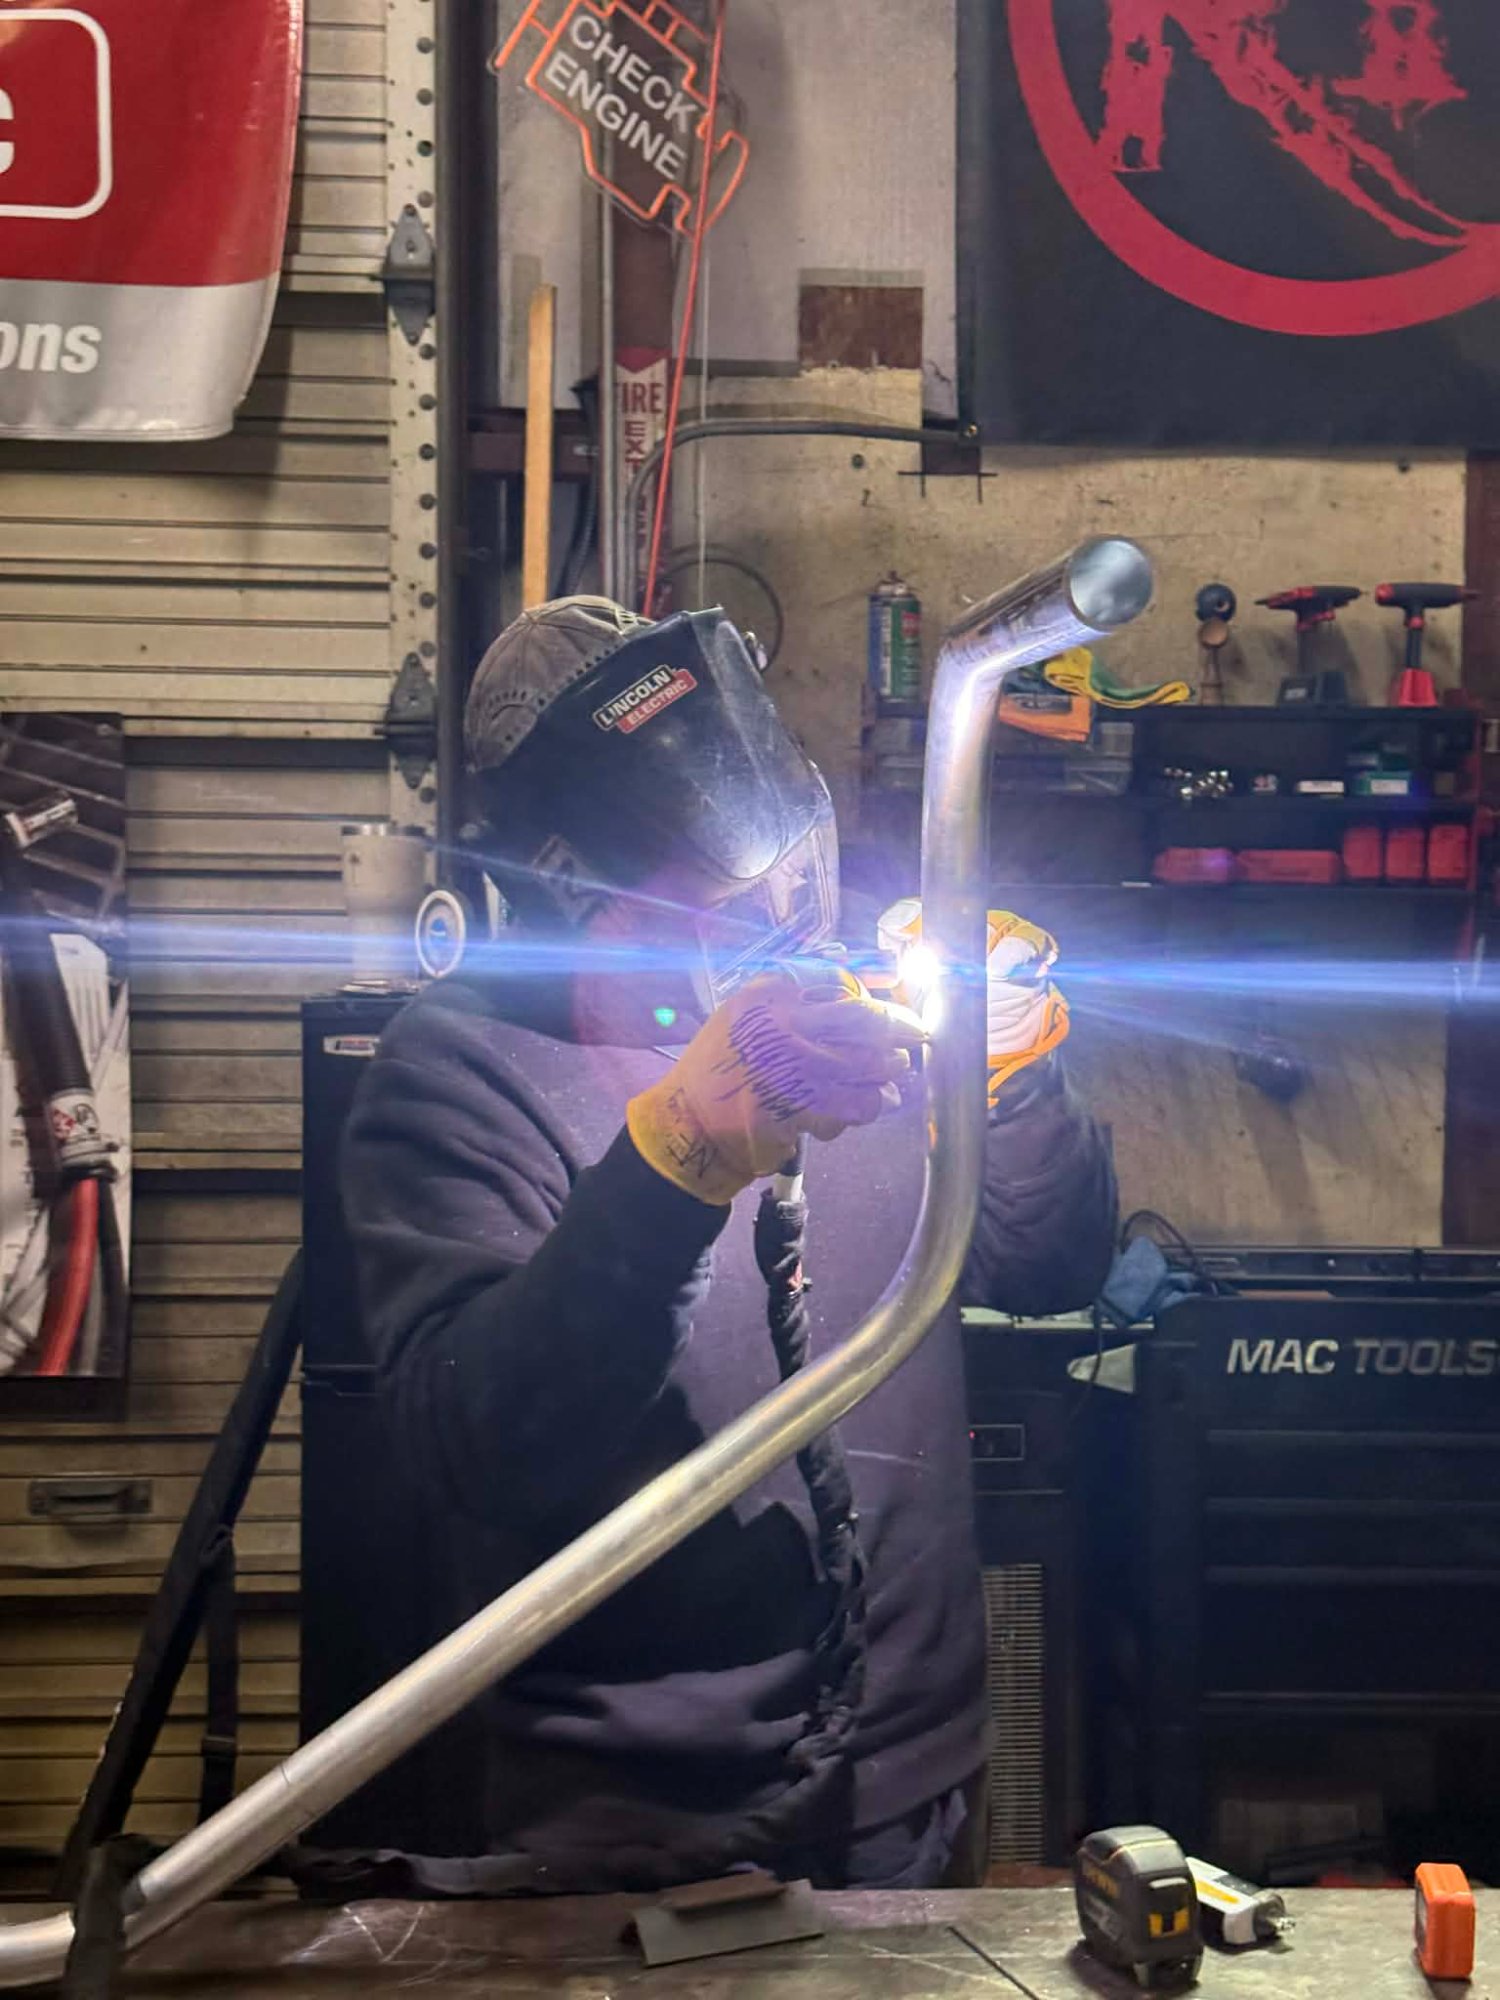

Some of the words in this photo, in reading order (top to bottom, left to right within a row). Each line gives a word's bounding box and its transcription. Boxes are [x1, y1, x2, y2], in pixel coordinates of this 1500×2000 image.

[570, 15, 698, 133] CHECK
[545, 52, 688, 180] ENGINE
[613, 382, 664, 413] IRE
[599, 670, 671, 725] LINCOLN
[628, 680, 688, 724] ELECTRIC
[1227, 1339, 1339, 1374] MAC
[1354, 1338, 1498, 1375] TOOLS
